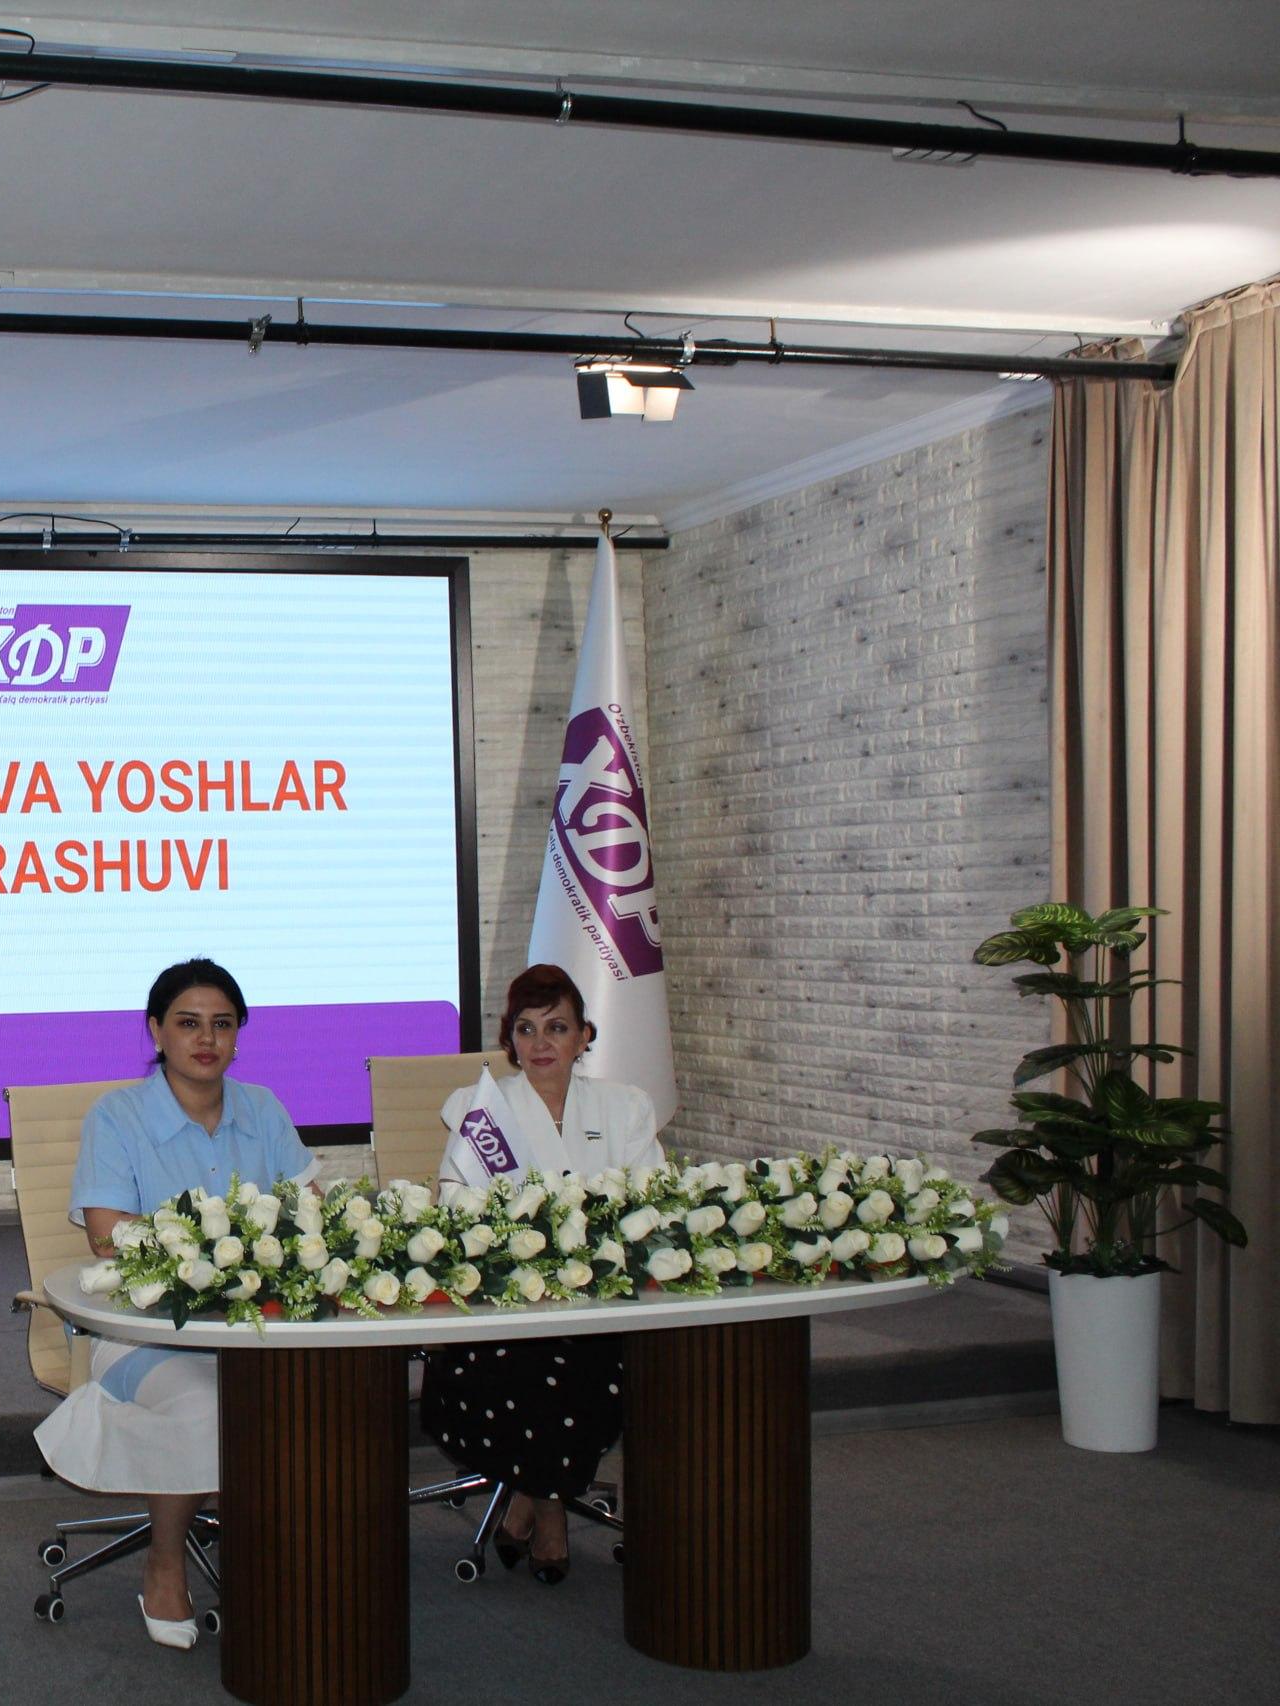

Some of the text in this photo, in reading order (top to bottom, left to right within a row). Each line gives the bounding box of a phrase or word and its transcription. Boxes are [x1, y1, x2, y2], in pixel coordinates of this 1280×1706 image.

[18, 695, 68, 704] demokratik
[70, 695, 108, 706] partiyasi
[77, 759, 348, 813] YOSHLAR
[552, 853, 592, 922] demokratik
[583, 924, 628, 981] partiyasi
[464, 1115, 508, 1168] XDP
